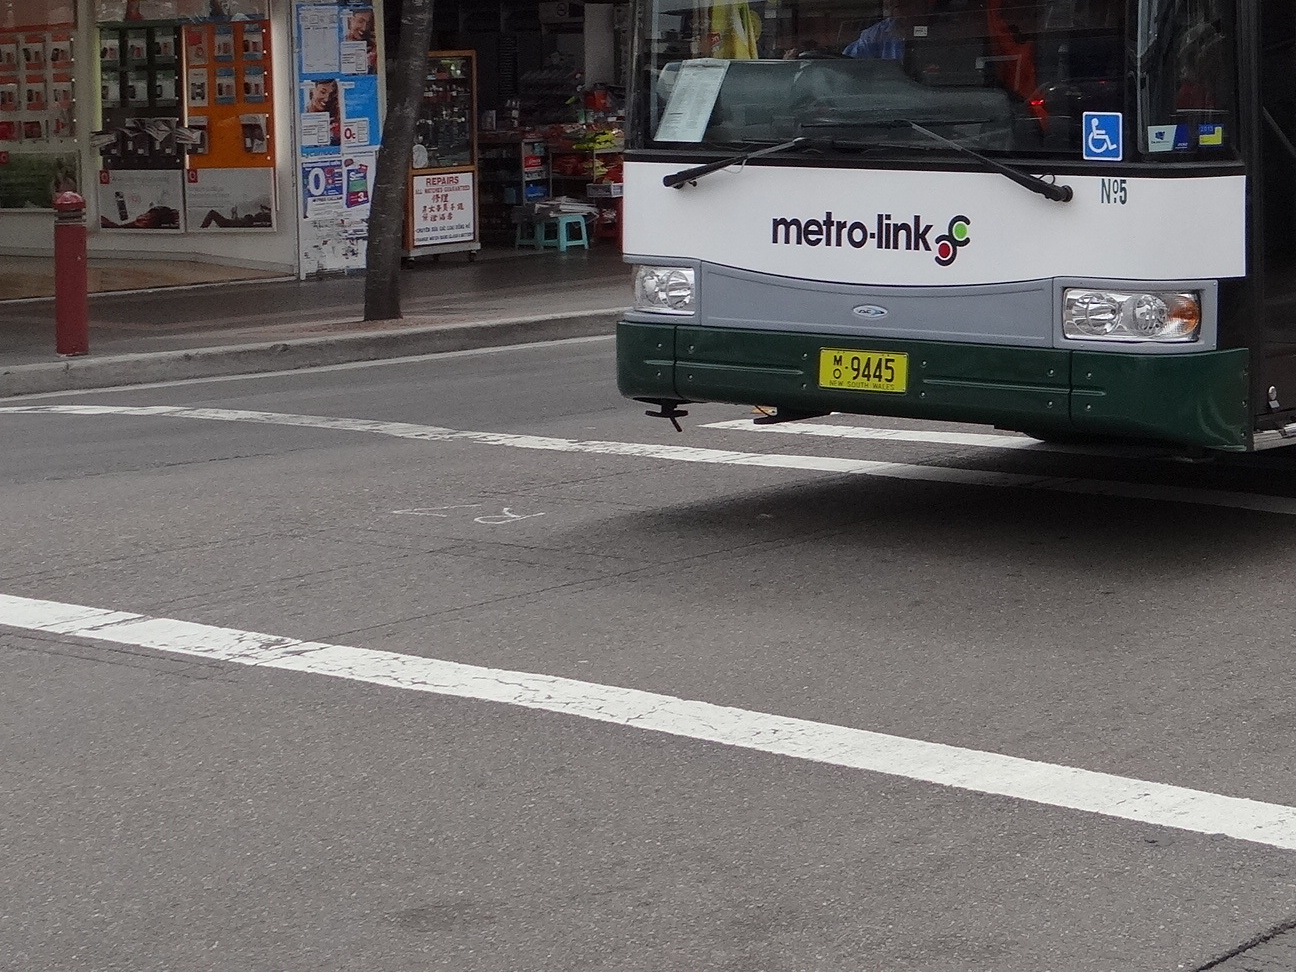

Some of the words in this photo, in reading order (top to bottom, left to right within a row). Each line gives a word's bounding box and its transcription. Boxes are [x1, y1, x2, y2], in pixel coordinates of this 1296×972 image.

[426, 176, 460, 186] REPAIRS
[771, 211, 934, 252] metro-link
[851, 356, 895, 383] 9445
[847, 380, 869, 388] SOUTH
[873, 383, 895, 391] WALES
